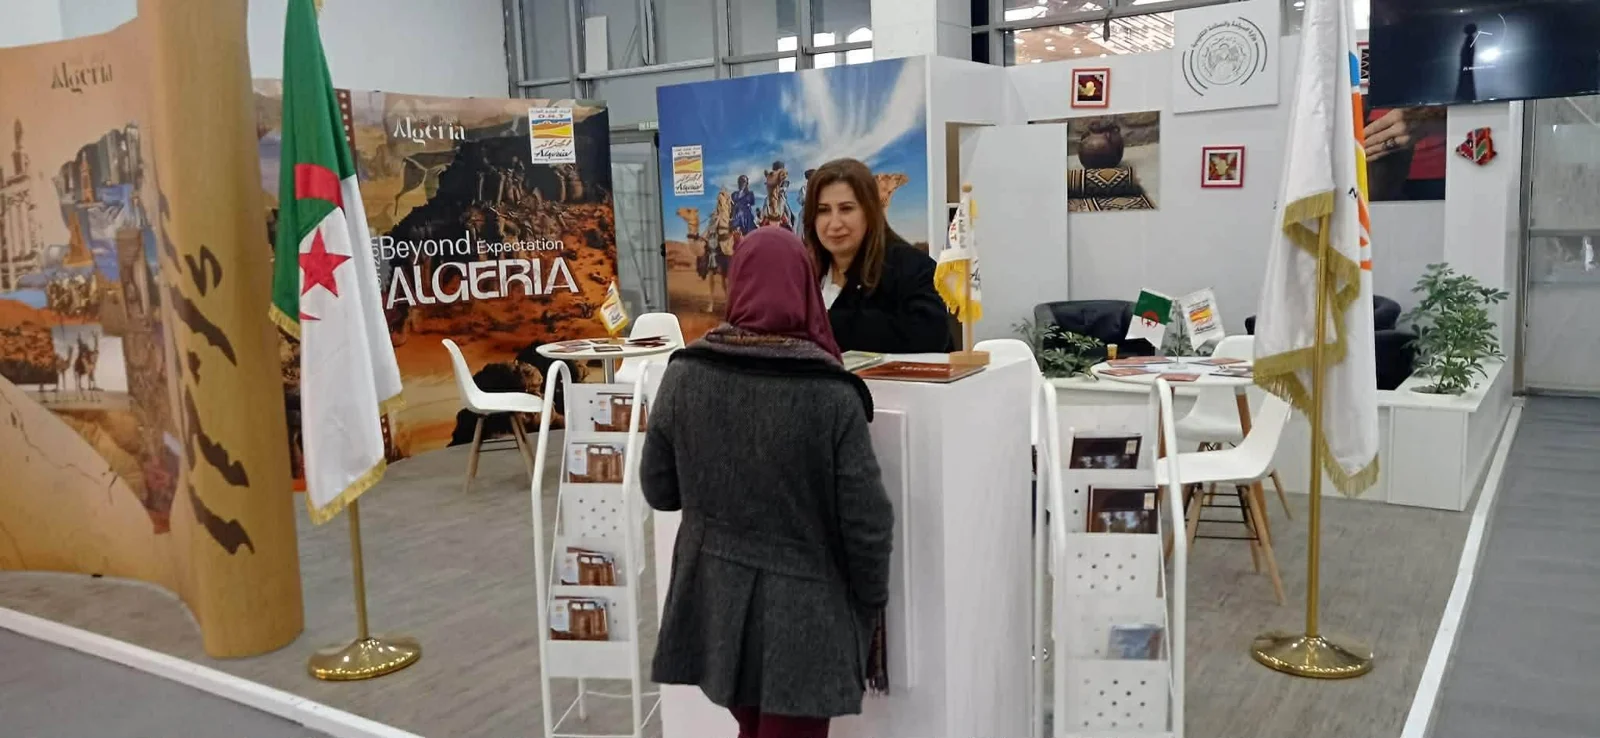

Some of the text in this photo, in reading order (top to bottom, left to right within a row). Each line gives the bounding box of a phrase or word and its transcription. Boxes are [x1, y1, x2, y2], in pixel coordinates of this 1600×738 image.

[393, 116, 465, 146] Algeria
[380, 230, 564, 265] Beyond Expectation
[386, 257, 579, 309] ALGERIA
